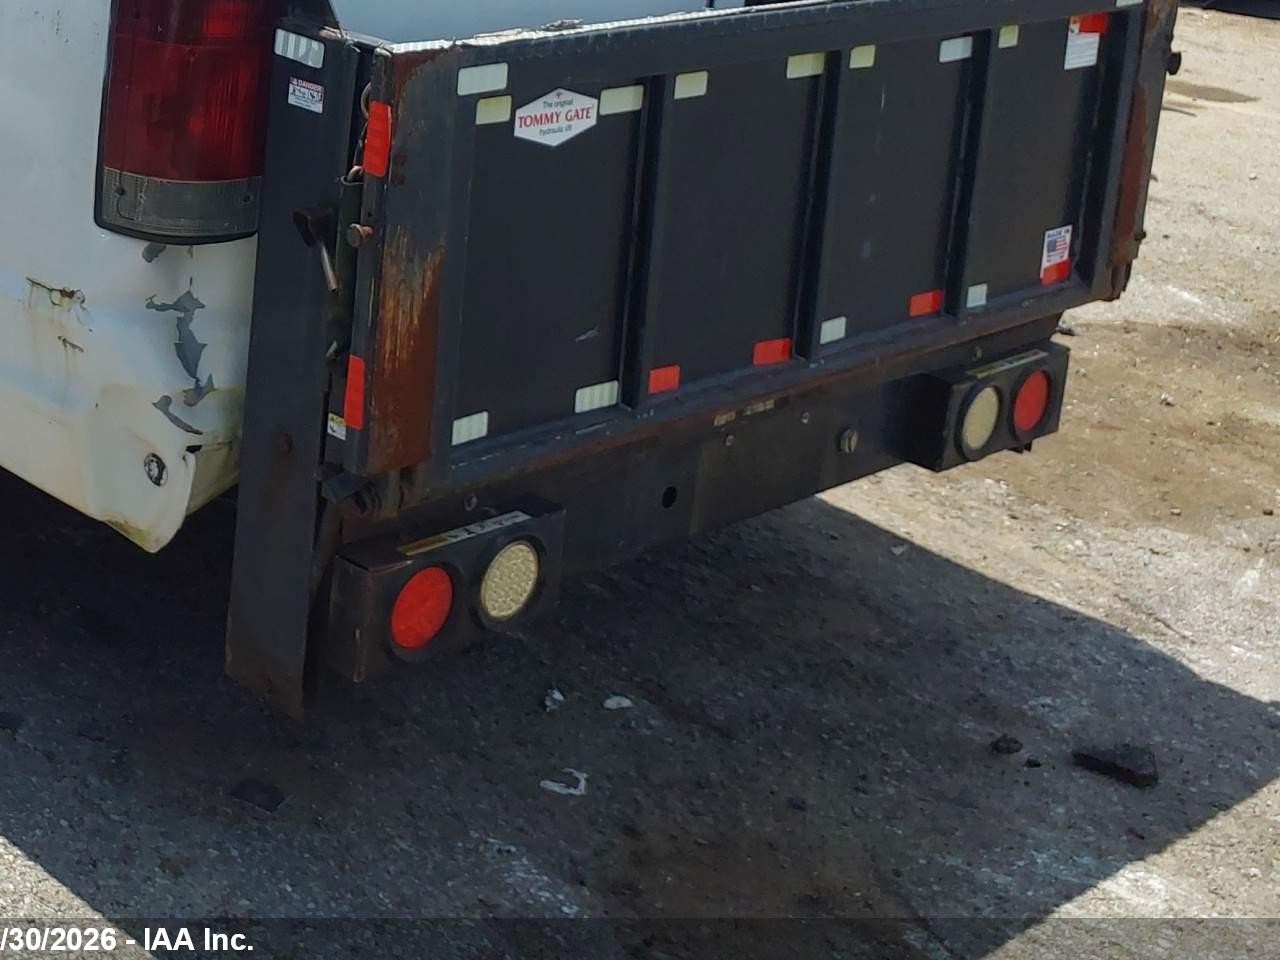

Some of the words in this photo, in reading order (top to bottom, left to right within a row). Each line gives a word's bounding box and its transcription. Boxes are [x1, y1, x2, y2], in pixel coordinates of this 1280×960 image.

[542, 100, 553, 109] The
[554, 97, 575, 109] original
[518, 111, 562, 129] TOMMY
[565, 106, 593, 122] GATE
